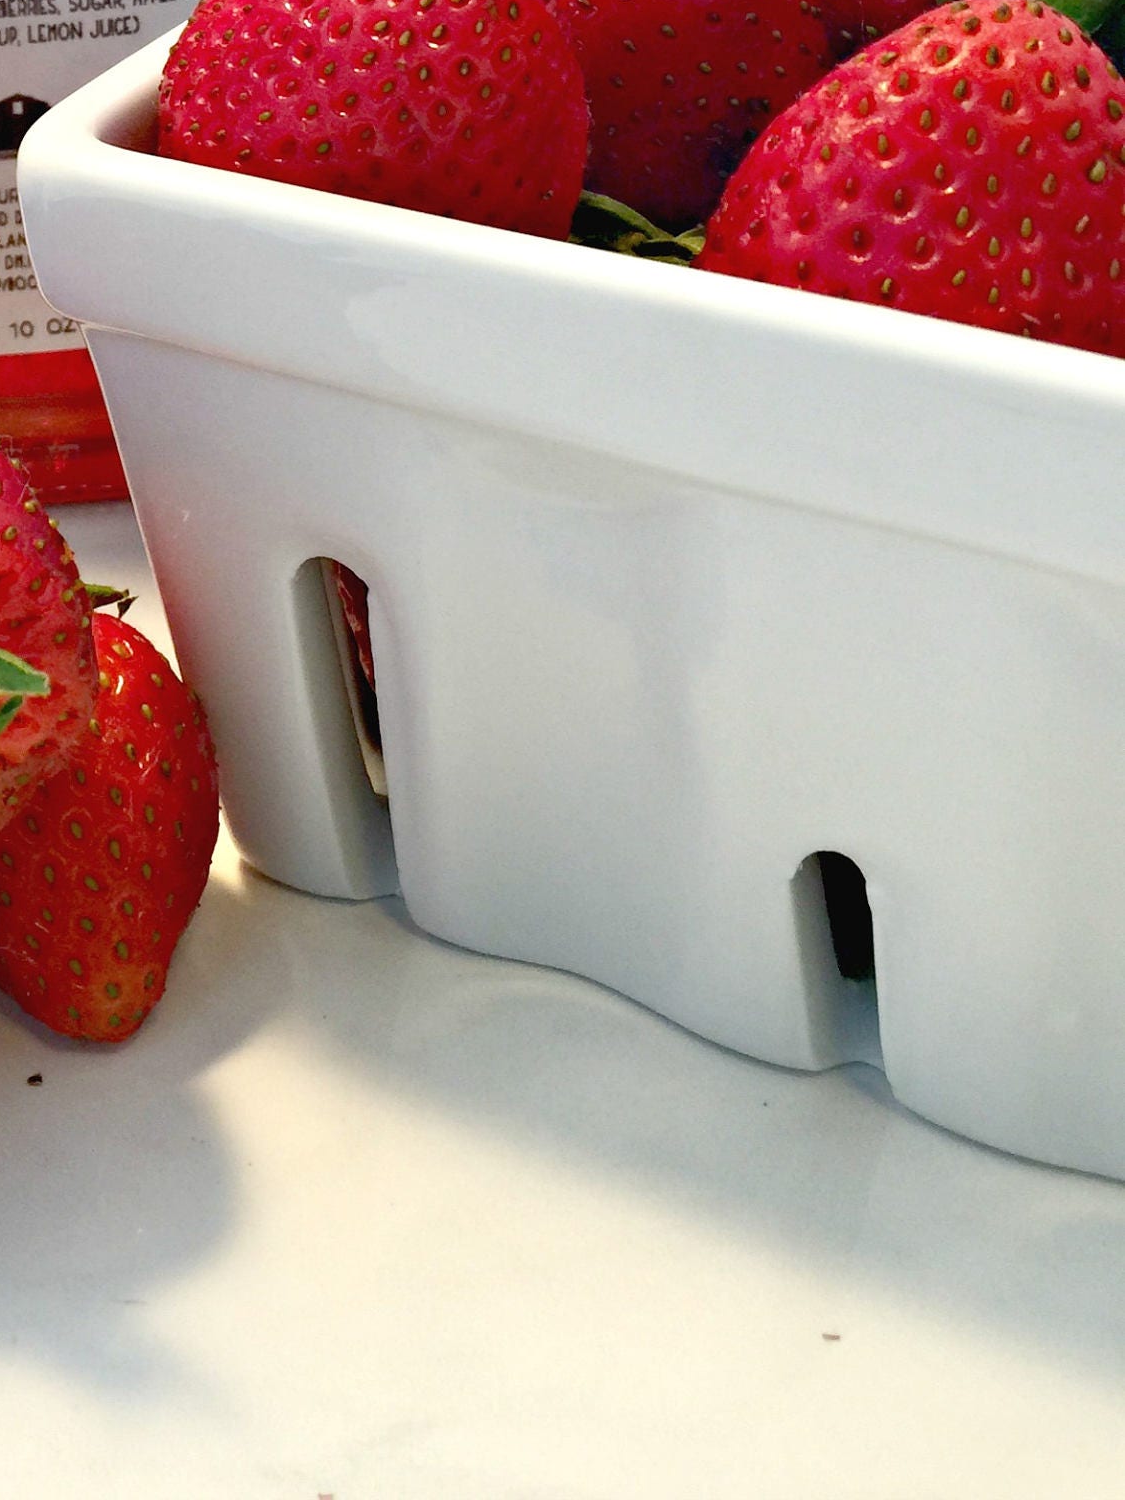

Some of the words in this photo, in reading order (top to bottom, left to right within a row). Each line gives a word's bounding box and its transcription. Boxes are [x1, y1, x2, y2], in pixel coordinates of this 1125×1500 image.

[26, 21, 83, 45] LEMON
[89, 15, 141, 40] JUICE)
[8, 320, 35, 339] 10
